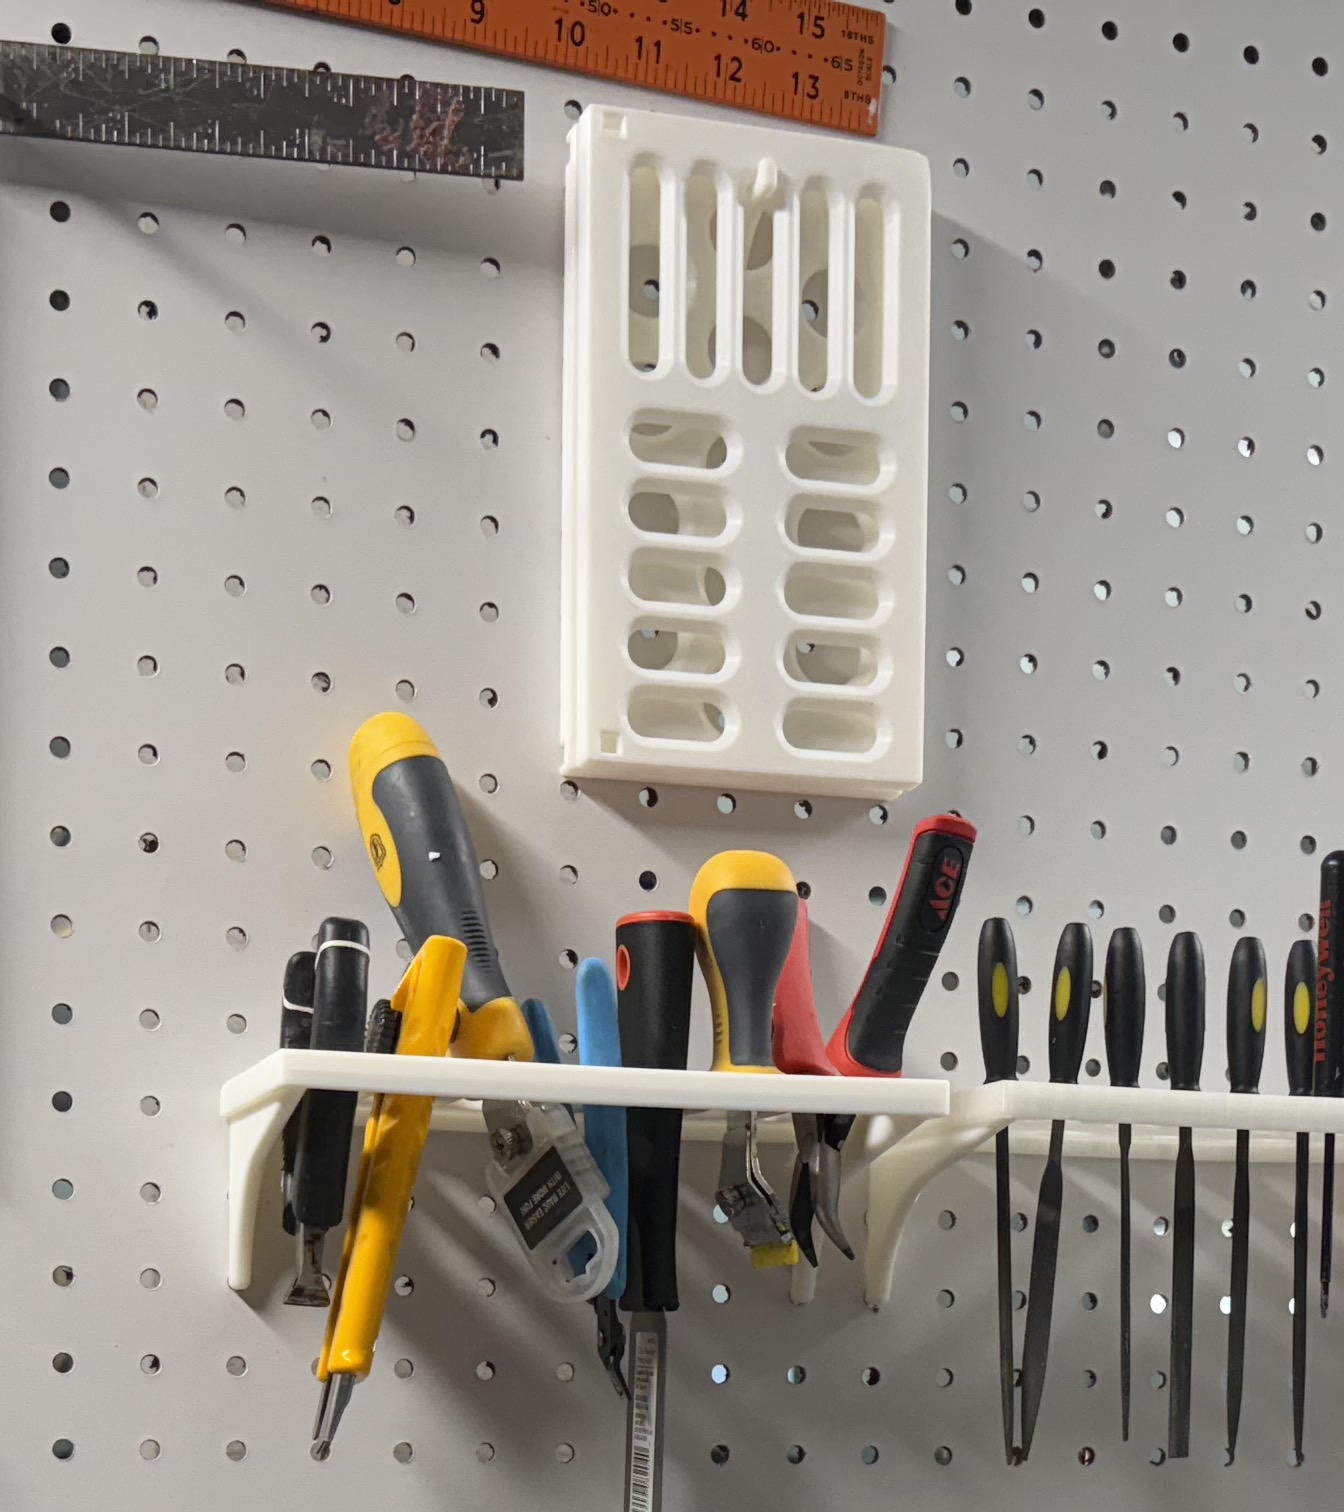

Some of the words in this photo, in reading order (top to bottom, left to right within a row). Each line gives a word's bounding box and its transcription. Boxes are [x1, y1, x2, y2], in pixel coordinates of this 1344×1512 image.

[471, 0, 486, 24] 9
[797, 12, 825, 39] 15
[554, 17, 585, 47] 10
[635, 36, 661, 64] 11
[714, 54, 743, 82] 12
[792, 72, 820, 100] 13
[929, 855, 960, 922] ACE
